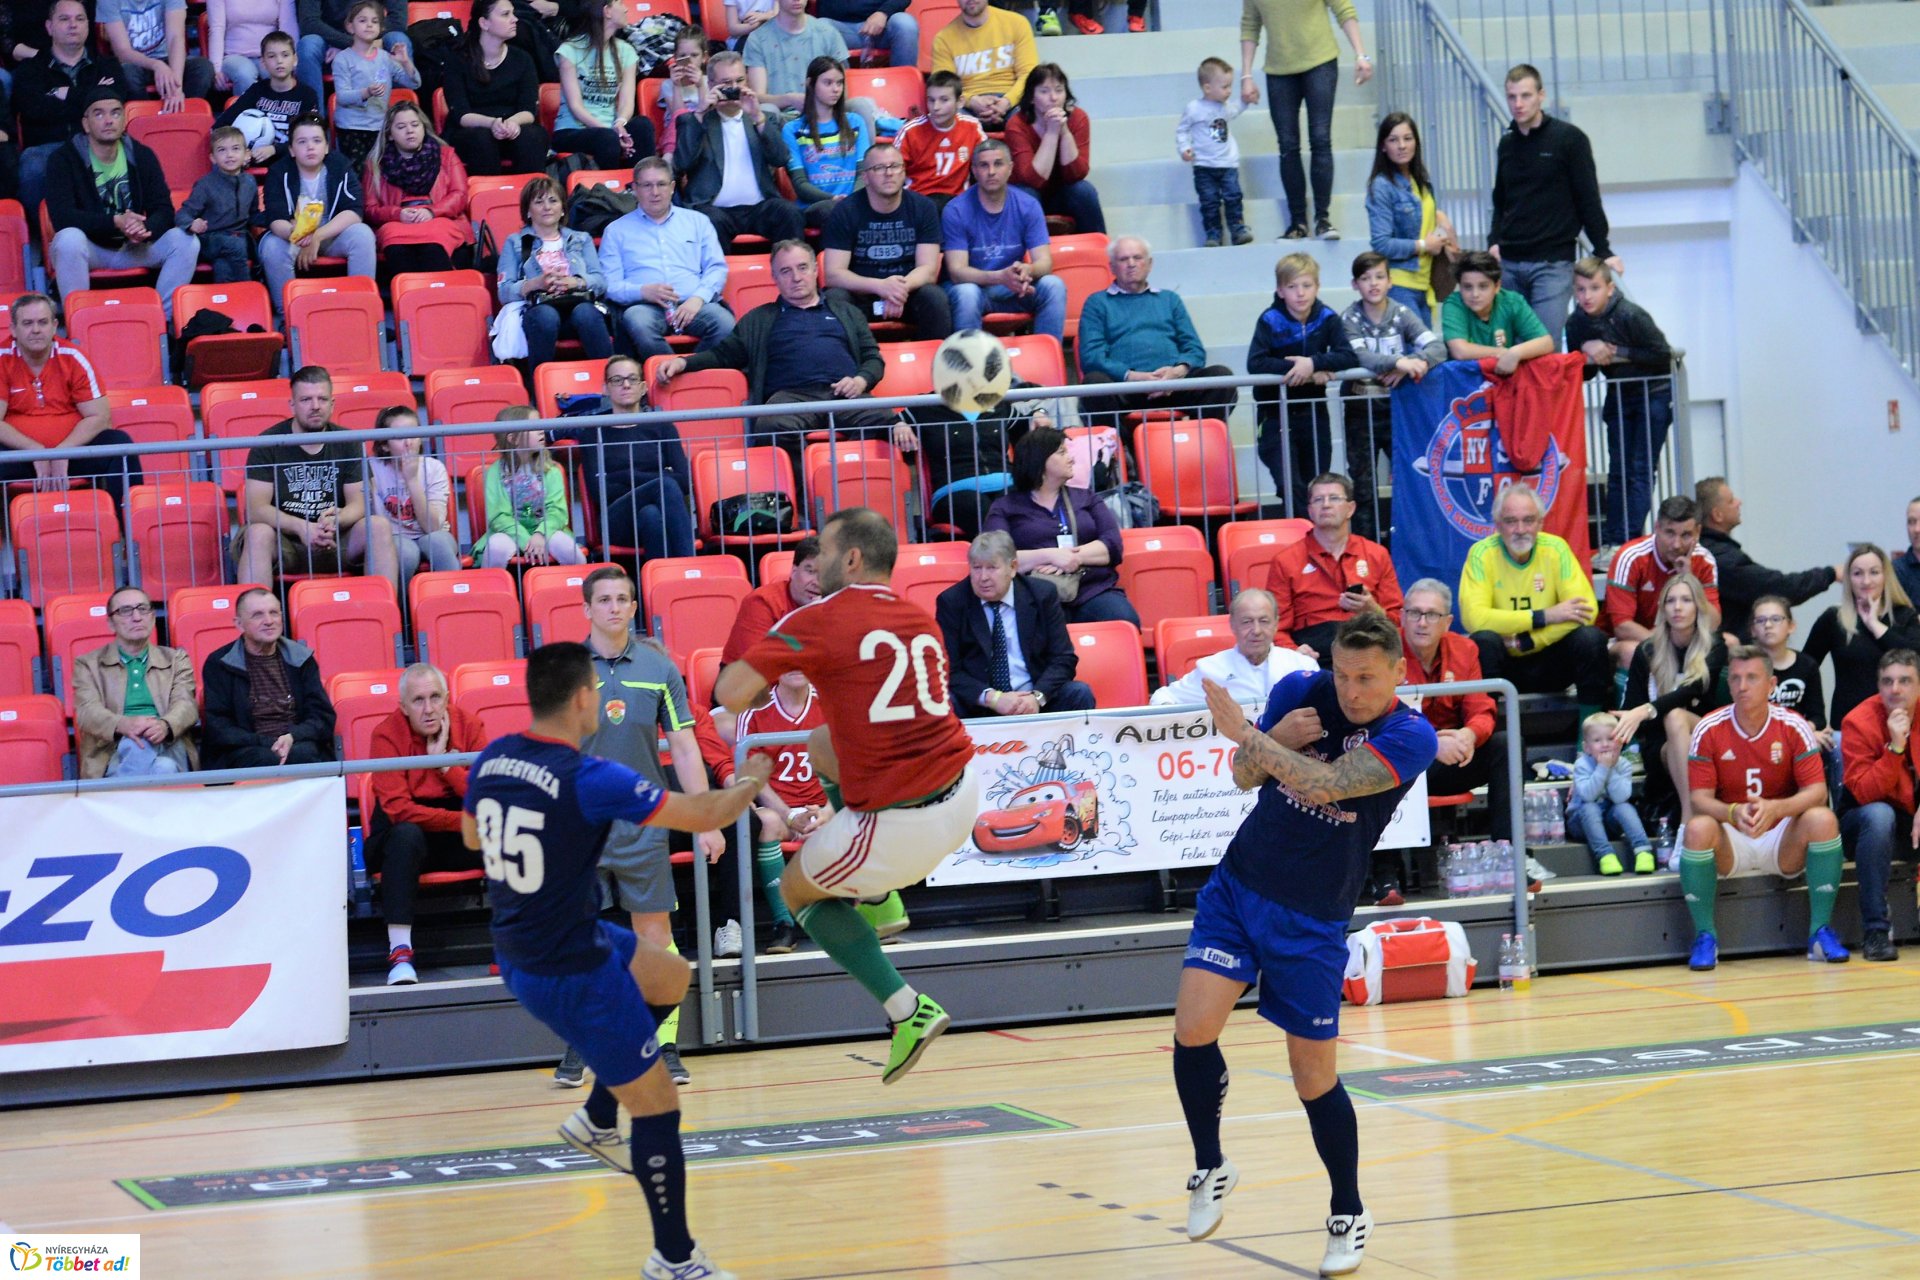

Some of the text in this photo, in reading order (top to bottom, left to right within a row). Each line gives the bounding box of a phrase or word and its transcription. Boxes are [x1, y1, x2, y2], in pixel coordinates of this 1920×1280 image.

[935, 151, 956, 176] 17
[1466, 437, 1488, 465] NY
[1476, 477, 1493, 505] F
[859, 629, 951, 724] 20
[476, 753, 561, 800] NYÍREGYHÁZA
[778, 751, 813, 782] 23
[1745, 767, 1763, 798] 5
